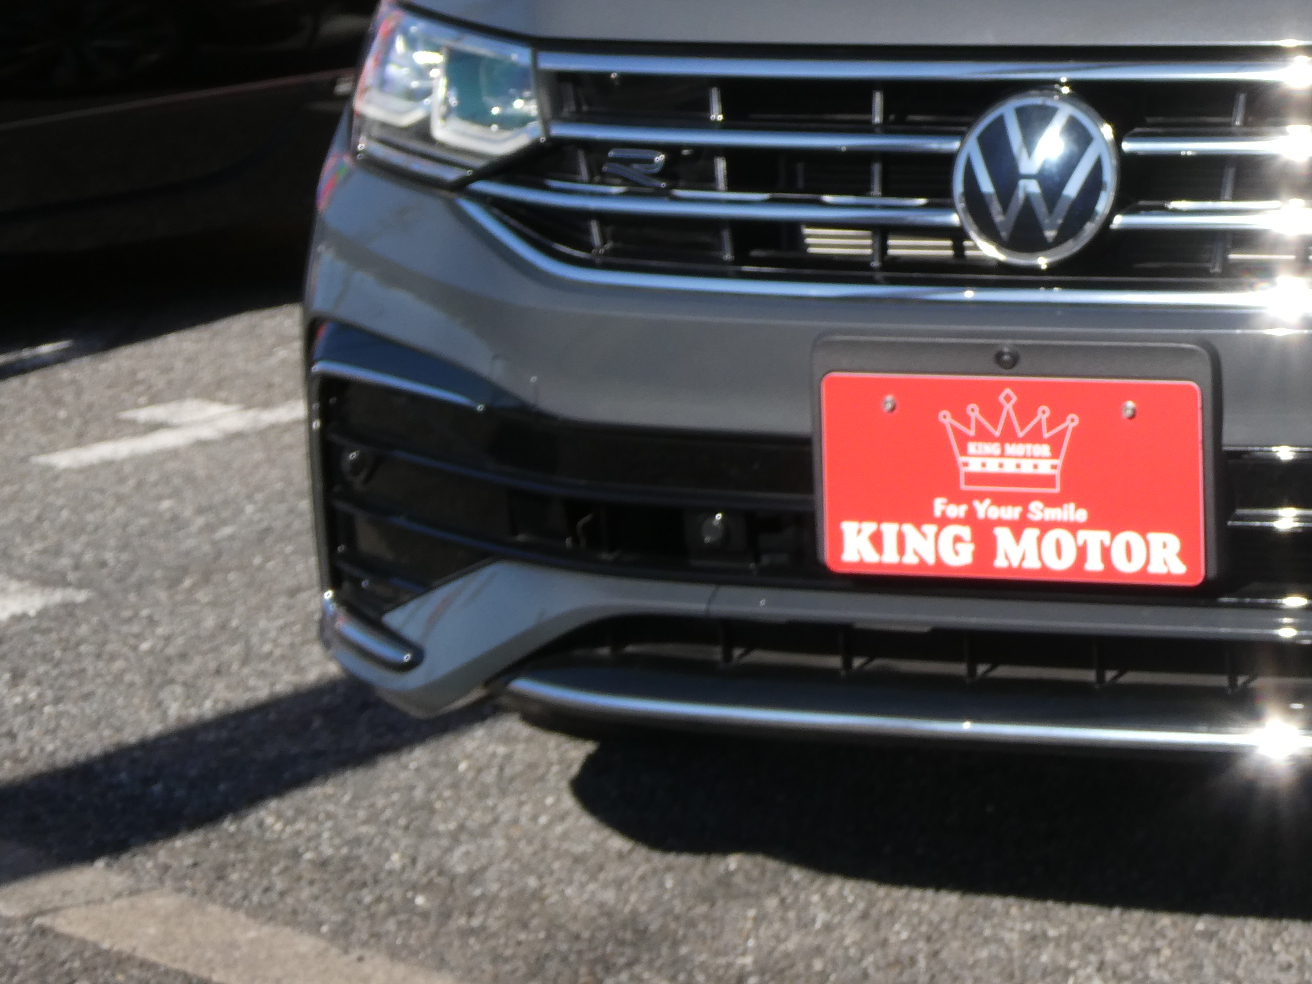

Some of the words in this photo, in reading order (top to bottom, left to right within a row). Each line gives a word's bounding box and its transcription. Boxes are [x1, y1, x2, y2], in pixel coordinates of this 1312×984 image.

[934, 498, 967, 519] For
[973, 499, 1022, 521] Your
[1027, 501, 1088, 523] Smile
[841, 521, 975, 566] KING
[994, 527, 1187, 576] MOTOR
